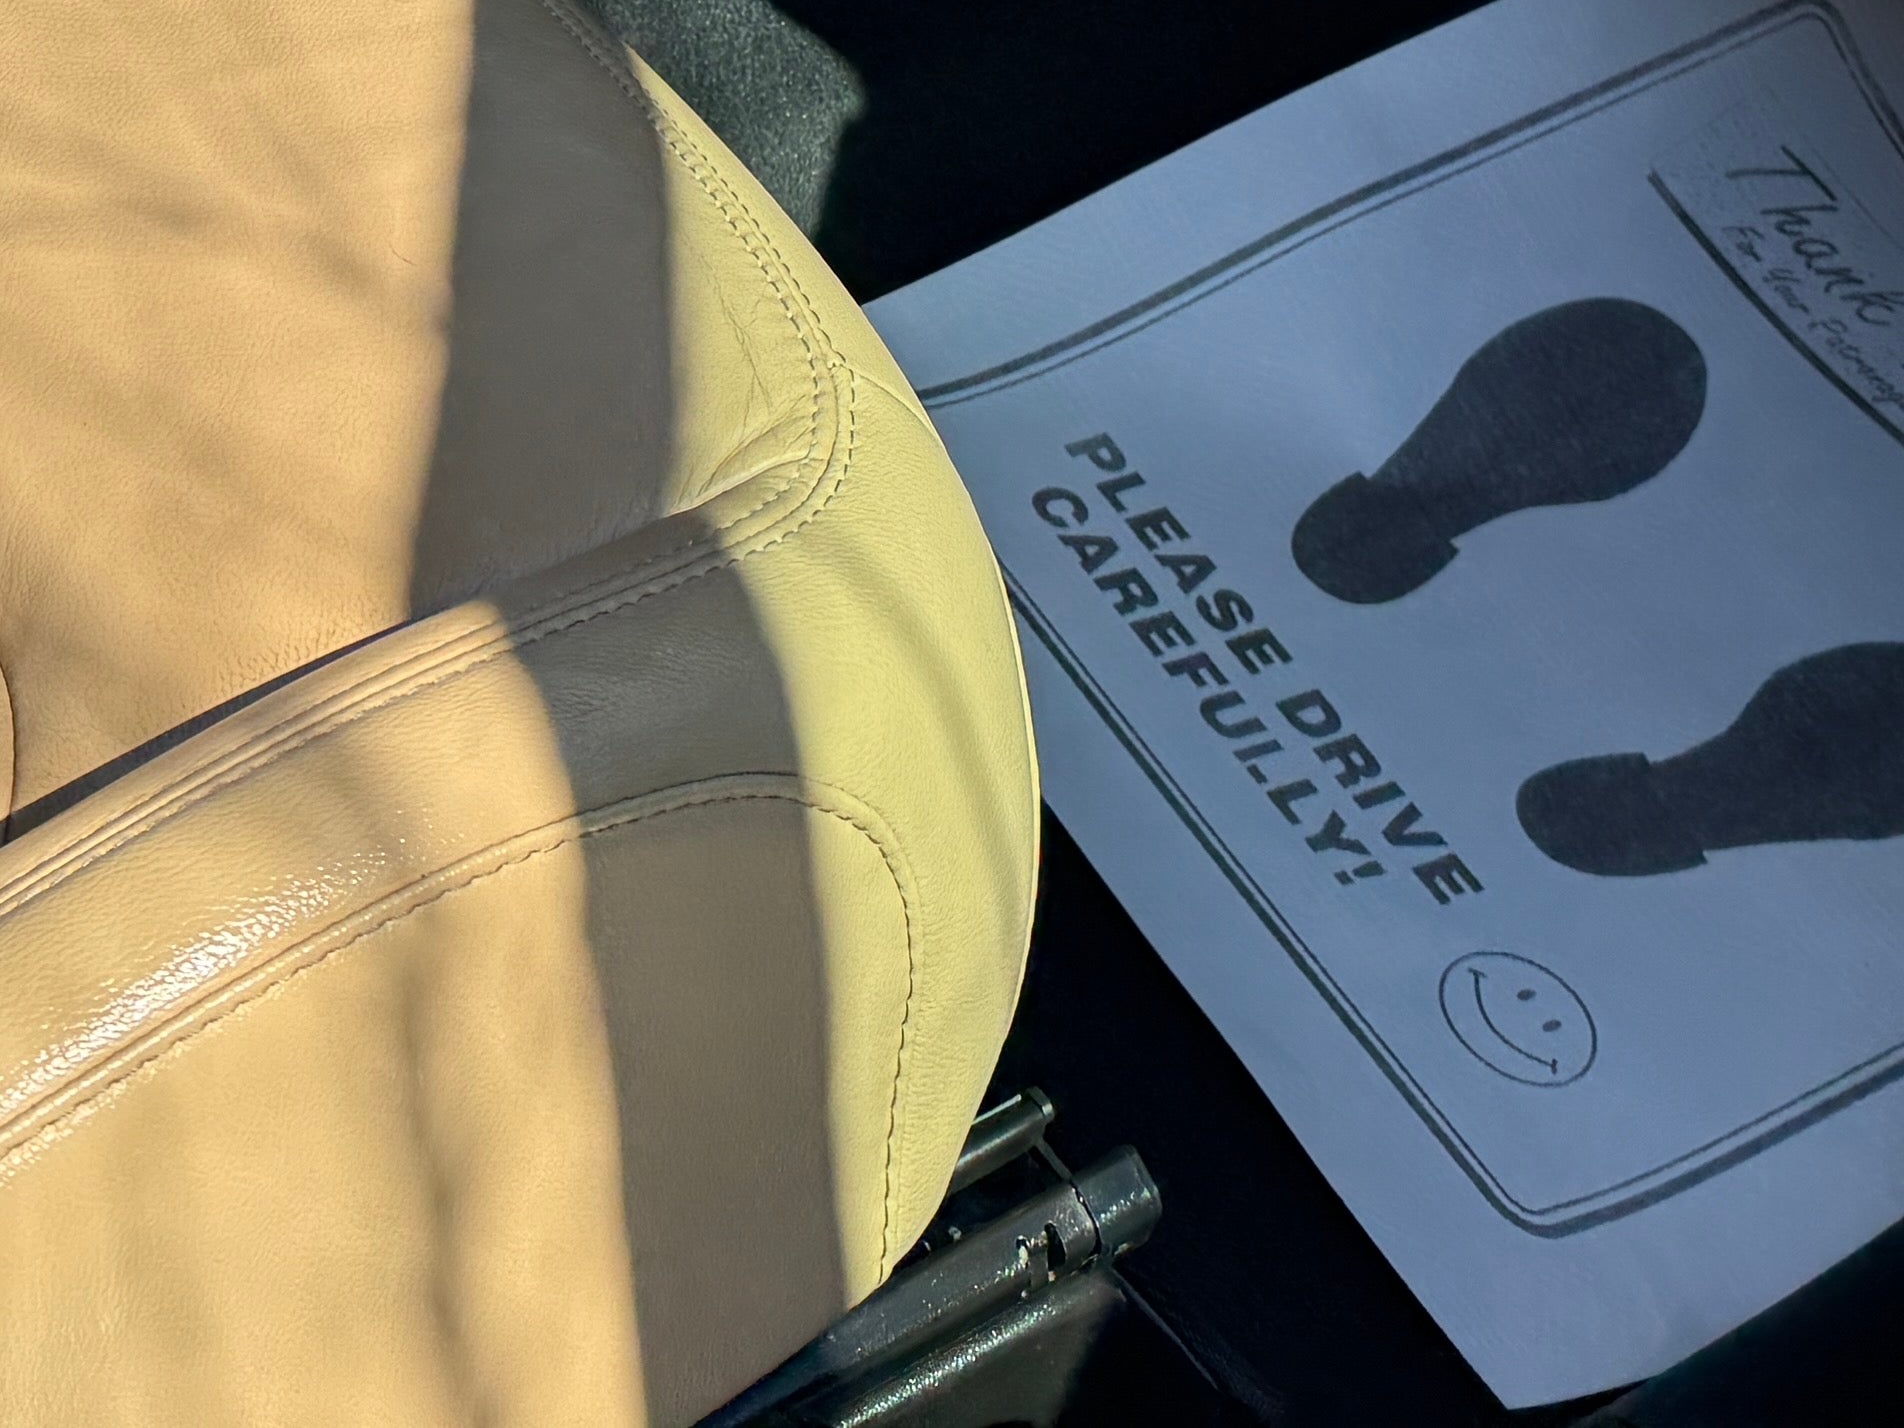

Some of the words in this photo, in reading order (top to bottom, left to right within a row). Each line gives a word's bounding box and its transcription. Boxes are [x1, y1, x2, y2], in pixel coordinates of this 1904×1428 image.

[1722, 225, 1765, 265] For
[1030, 485, 1389, 886] CAREFULLY!
[1064, 430, 1294, 677] PLEASE
[1276, 687, 1486, 907] DRIVE
